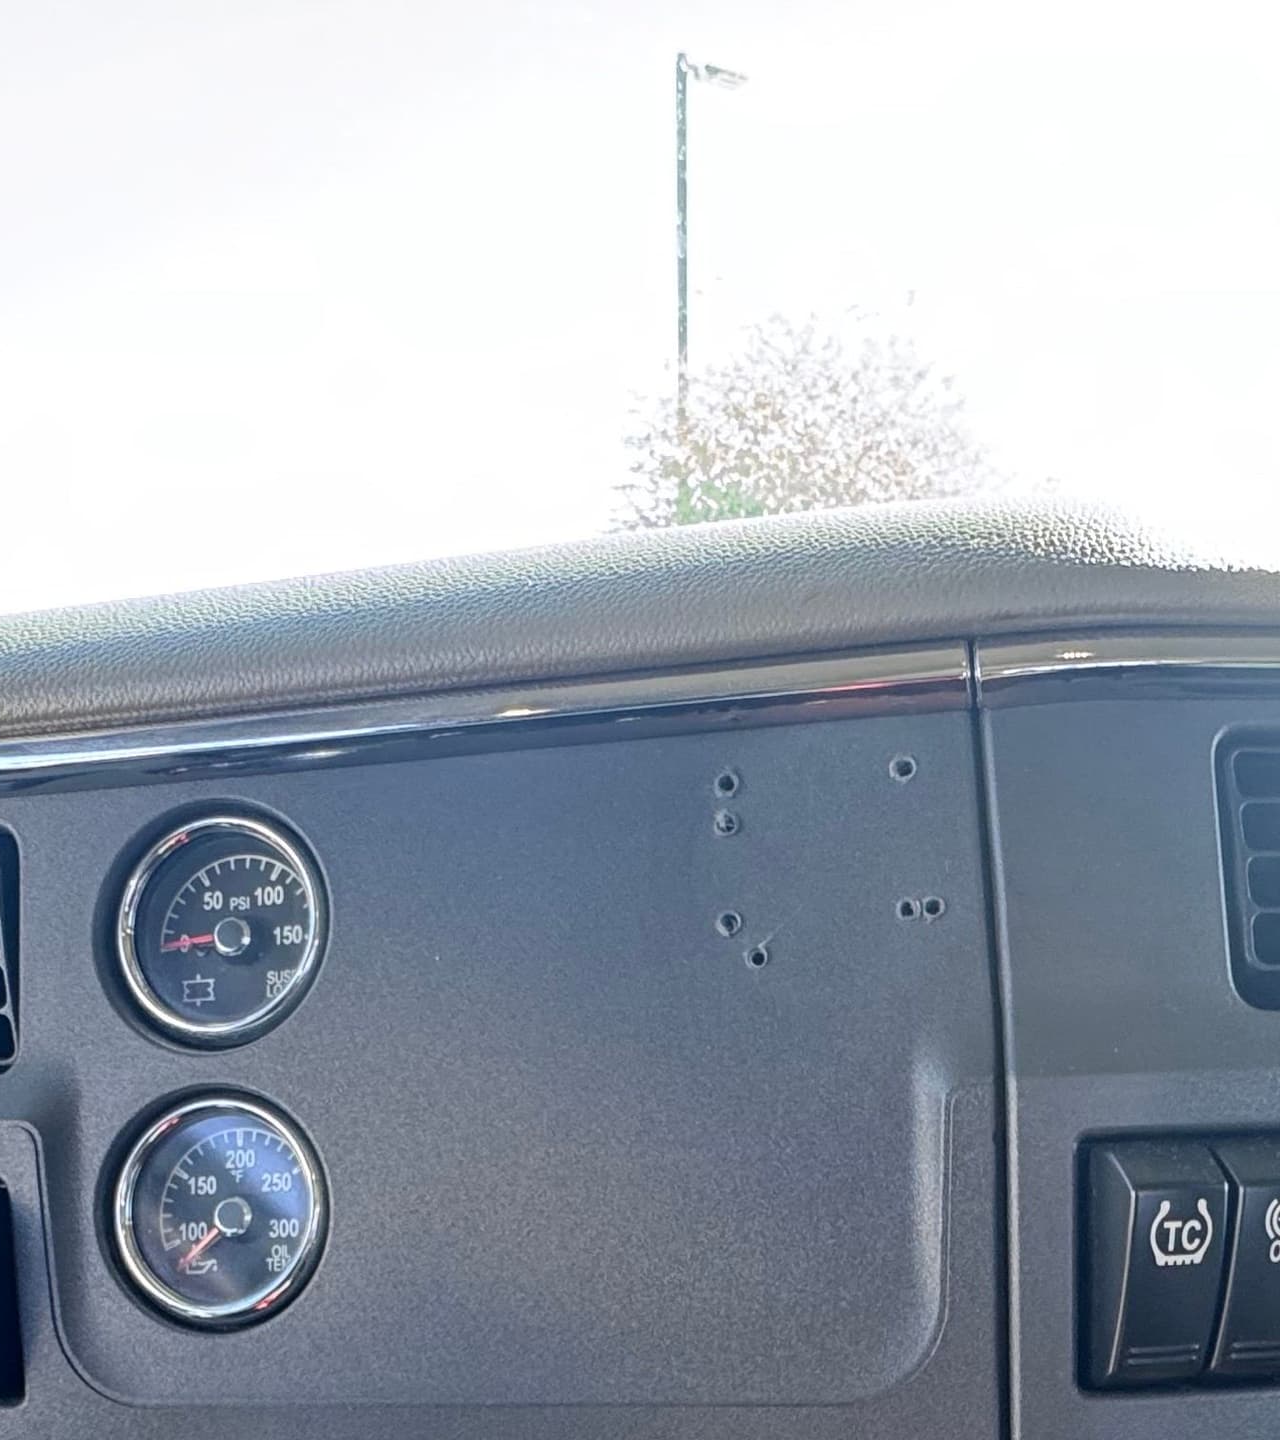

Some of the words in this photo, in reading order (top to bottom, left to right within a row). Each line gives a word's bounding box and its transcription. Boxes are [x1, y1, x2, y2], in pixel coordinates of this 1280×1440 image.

[203, 890, 223, 911] 50
[229, 896, 251, 911] PSI
[254, 886, 284, 907] 100
[273, 925, 303, 945] 150
[225, 1150, 256, 1169] 200
[187, 1176, 217, 1195] 150
[261, 1173, 292, 1193] 250
[179, 1223, 208, 1241] 100
[270, 1219, 299, 1238] 300
[1163, 1220, 1201, 1251] TC
[271, 1245, 290, 1259] OIL
